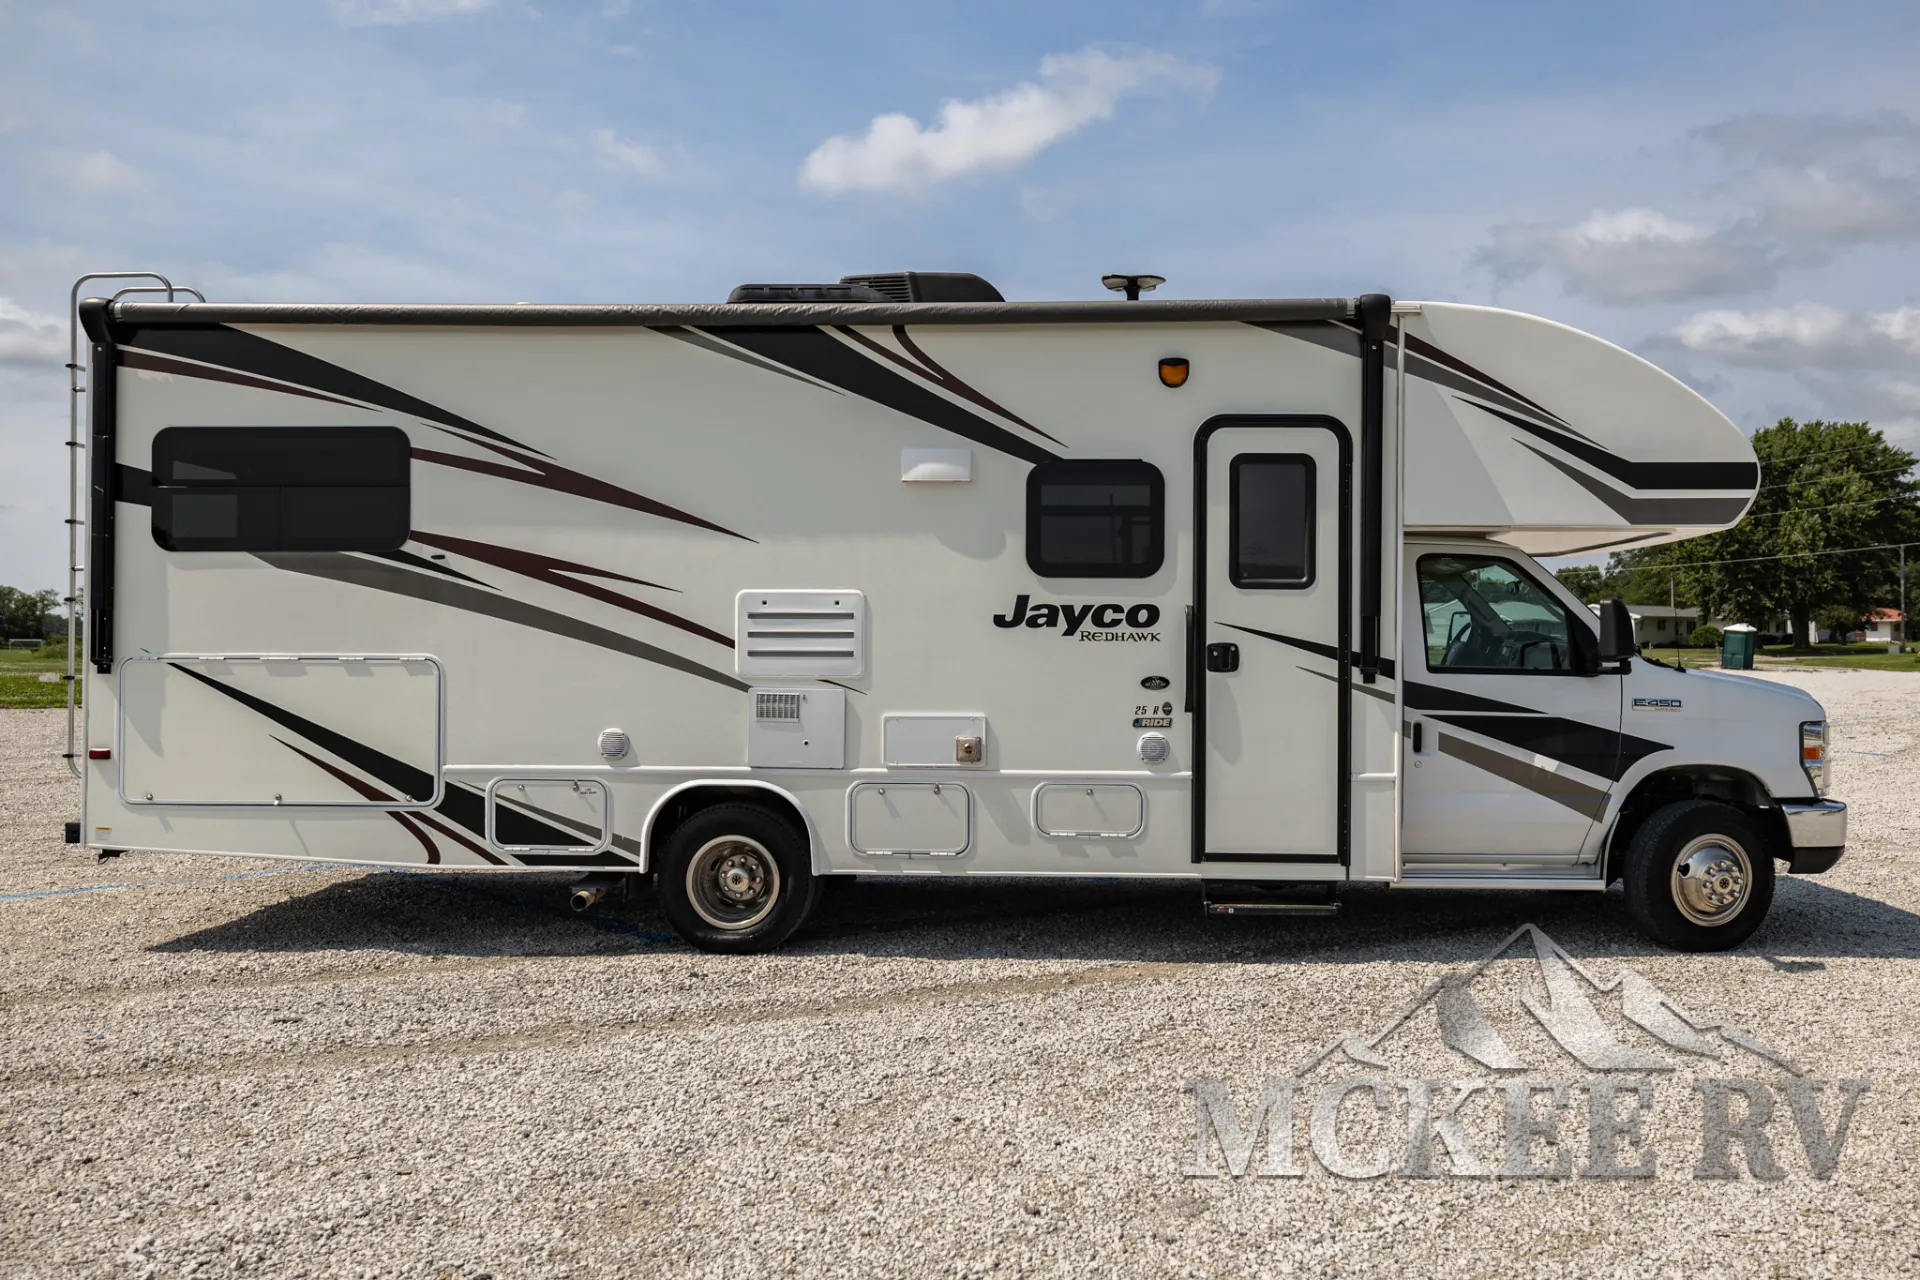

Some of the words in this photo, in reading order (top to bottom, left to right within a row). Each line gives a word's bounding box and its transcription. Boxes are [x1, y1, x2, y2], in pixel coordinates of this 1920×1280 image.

[993, 594, 1161, 637] Jayco
[1079, 630, 1161, 642] REDHAWK
[1134, 705, 1148, 716] 25
[1152, 705, 1160, 716] R
